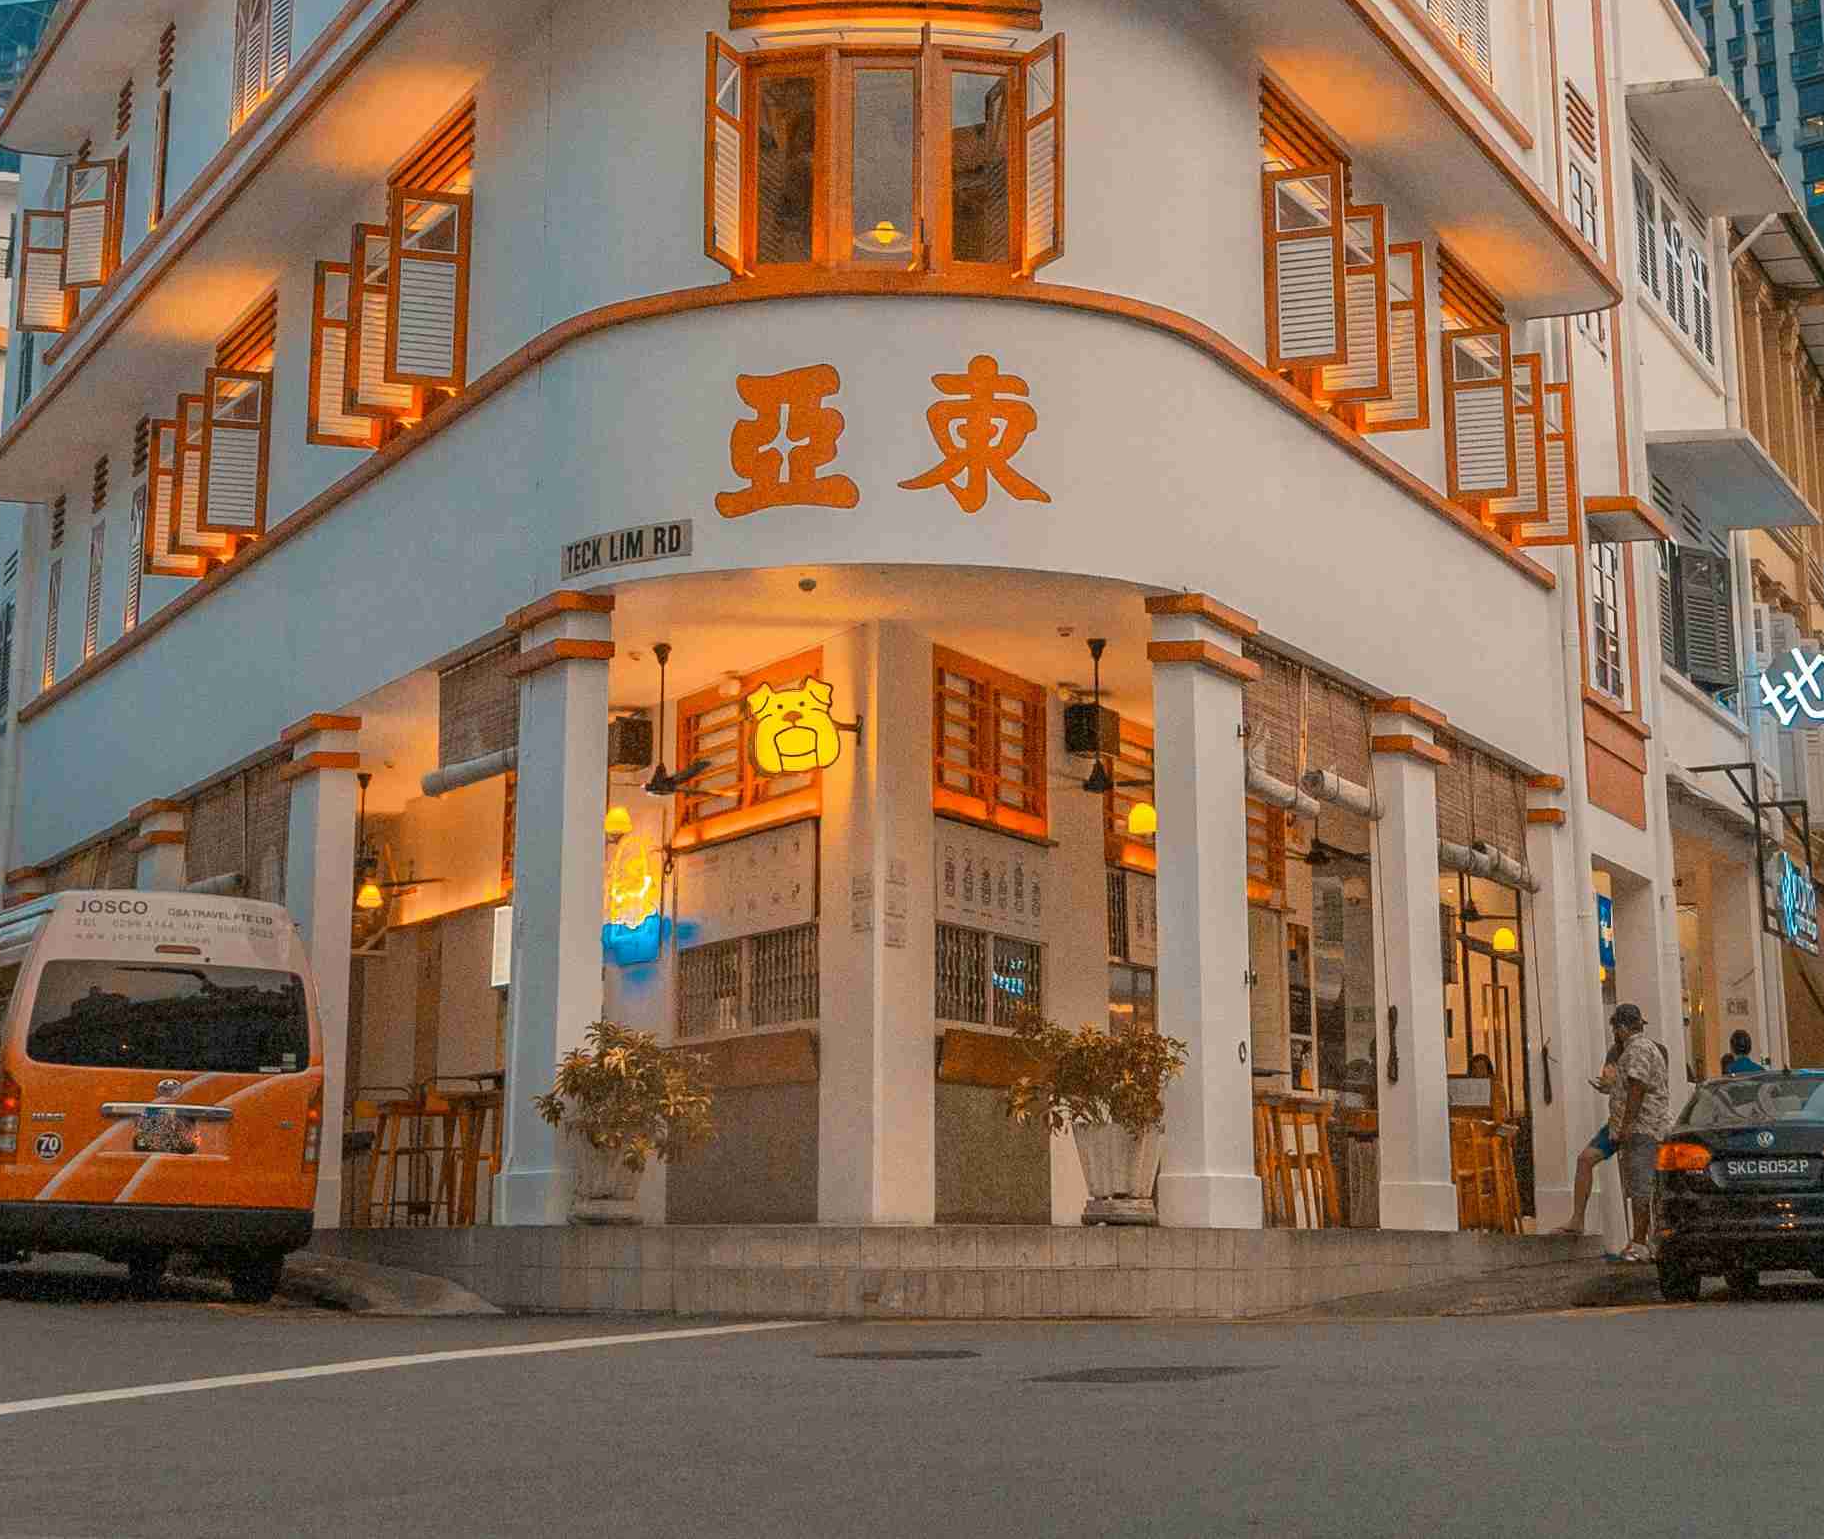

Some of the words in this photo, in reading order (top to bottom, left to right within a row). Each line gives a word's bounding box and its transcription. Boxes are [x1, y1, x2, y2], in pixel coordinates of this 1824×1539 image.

[567, 537, 601, 574] TECK
[609, 529, 643, 562] LIM
[653, 524, 681, 555] RD
[75, 899, 148, 915] JOSCO
[192, 909, 231, 920] TRAVEL
[39, 1135, 59, 1151] 70
[1727, 1160, 1809, 1176] SKC6052P
